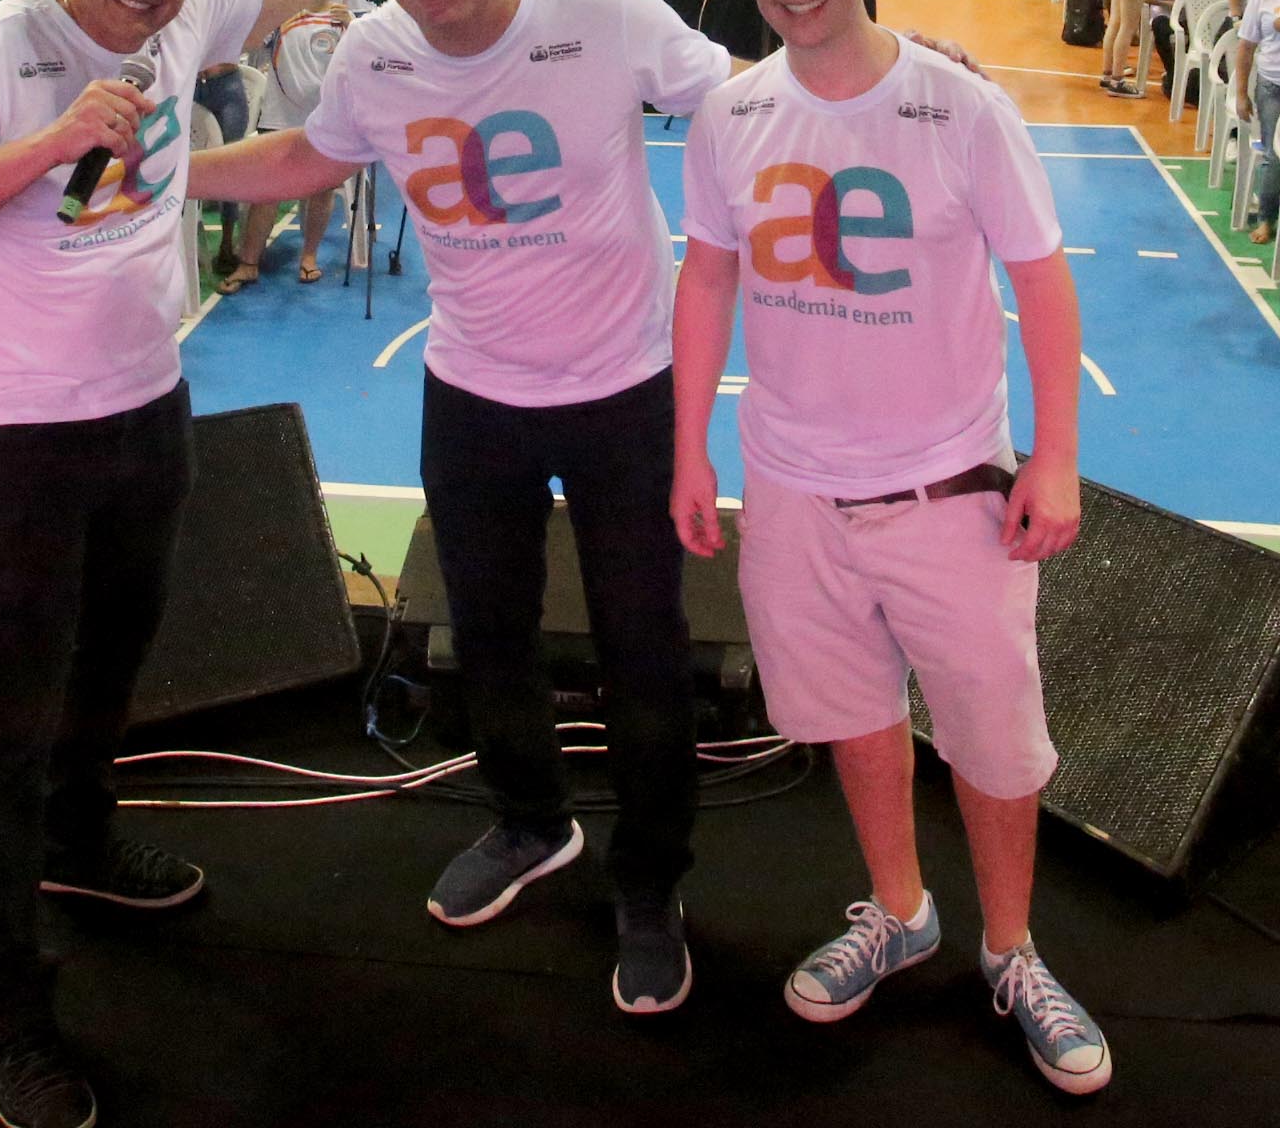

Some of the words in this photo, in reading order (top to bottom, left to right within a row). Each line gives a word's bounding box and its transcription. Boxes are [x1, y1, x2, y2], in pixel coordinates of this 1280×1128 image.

[507, 231, 567, 249] enem
[753, 289, 848, 319] academia
[852, 309, 913, 326] enem
